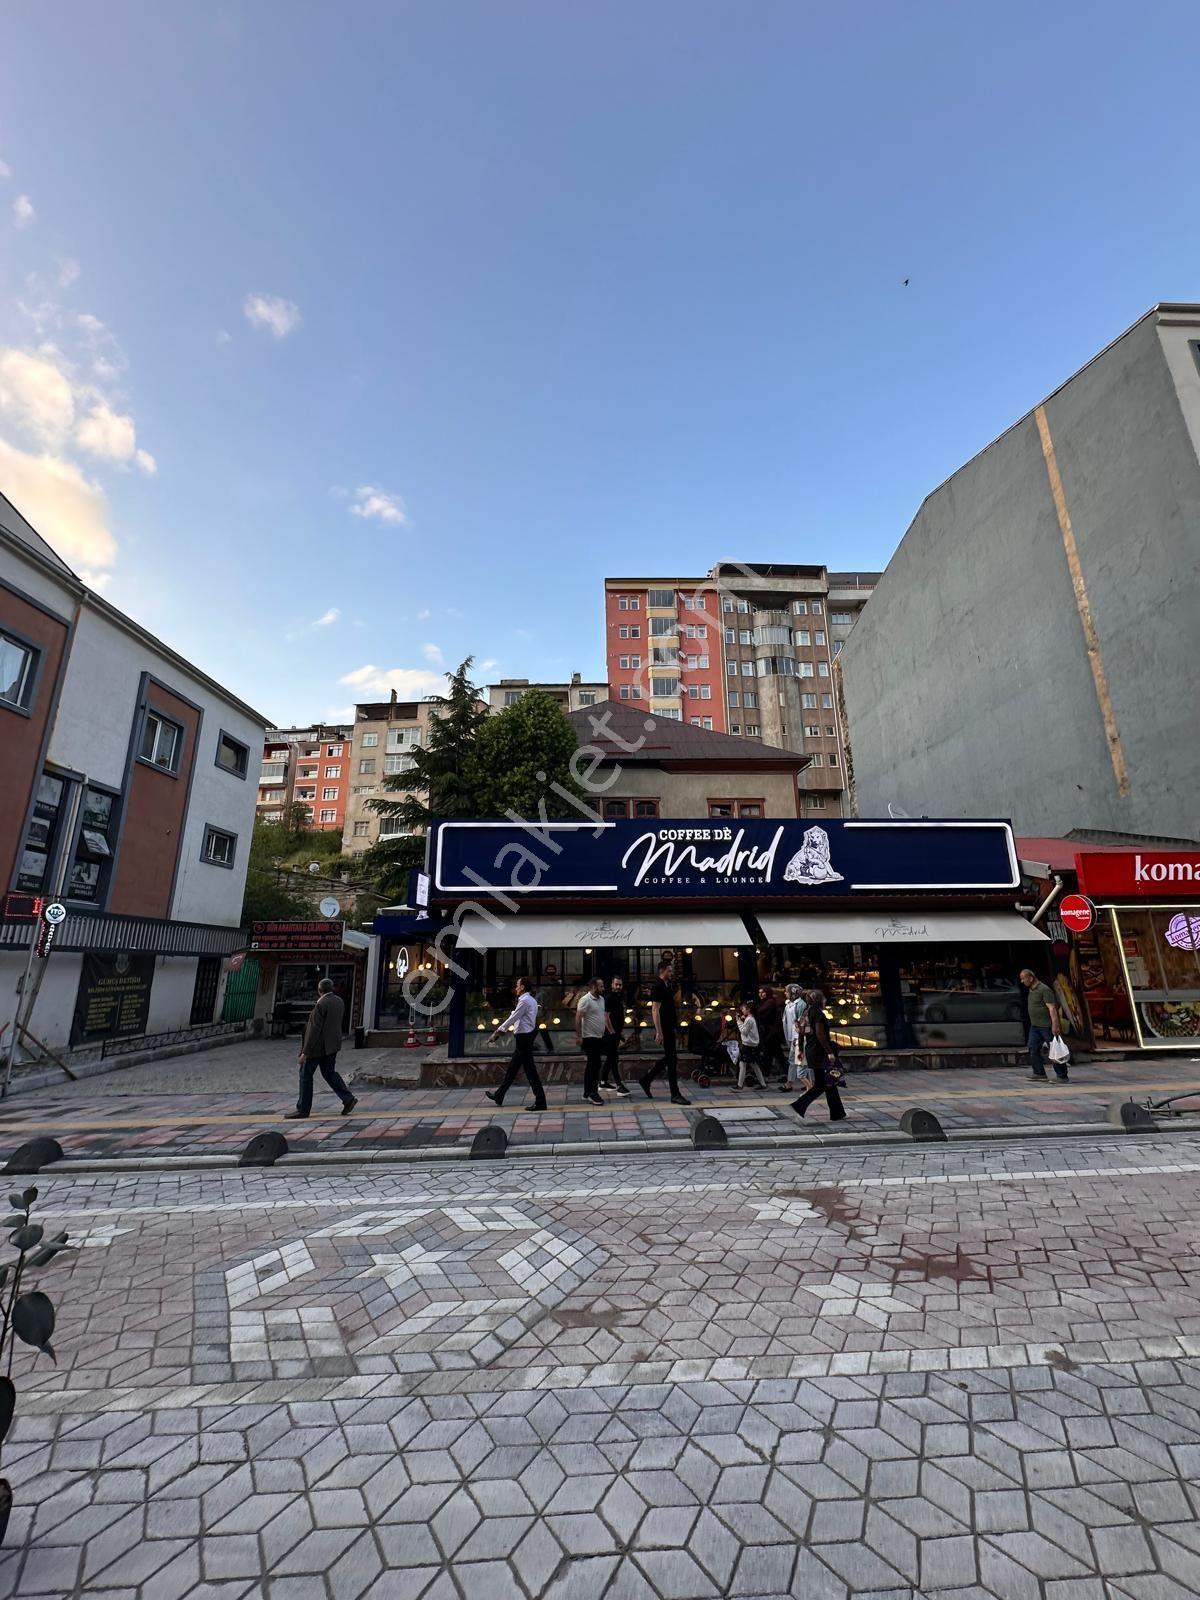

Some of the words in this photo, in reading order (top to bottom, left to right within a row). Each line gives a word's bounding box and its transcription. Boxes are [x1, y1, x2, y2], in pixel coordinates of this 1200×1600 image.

[659, 829, 711, 841] COFFEE
[621, 825, 785, 887] Madrid
[1060, 908, 1091, 918] komagene
